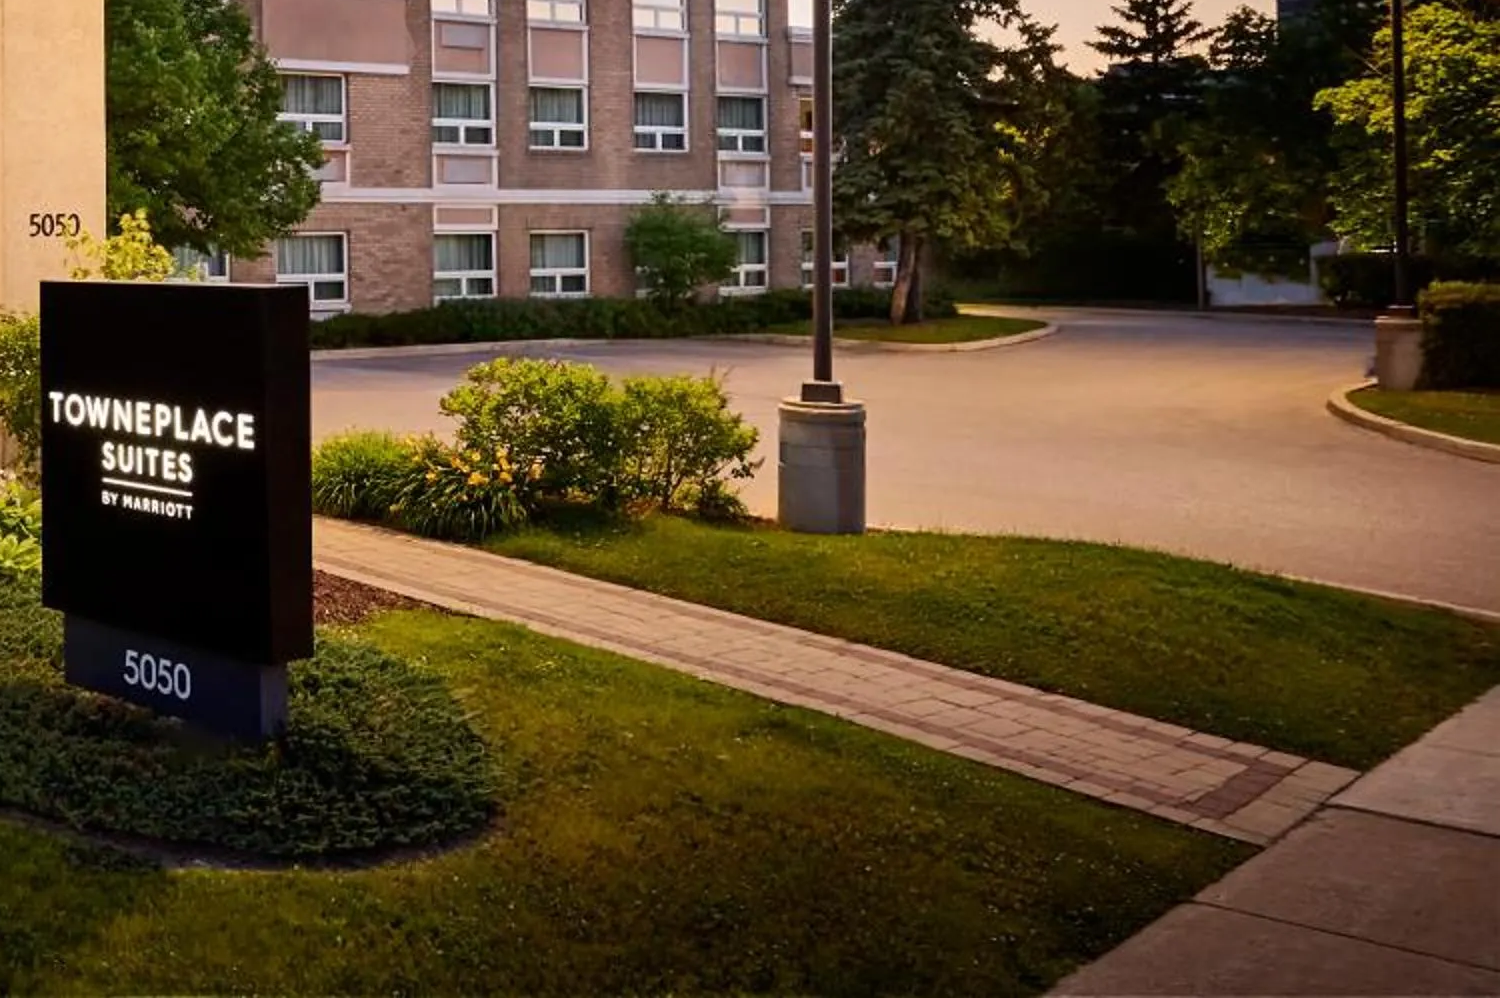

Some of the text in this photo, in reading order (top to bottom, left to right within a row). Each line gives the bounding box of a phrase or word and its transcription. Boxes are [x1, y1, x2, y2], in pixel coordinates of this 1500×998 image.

[49, 391, 255, 449] TOWNEPLACE
[102, 441, 193, 483] SUITES
[102, 490, 193, 519] BY MARRIOTT
[123, 649, 191, 699] 5050
